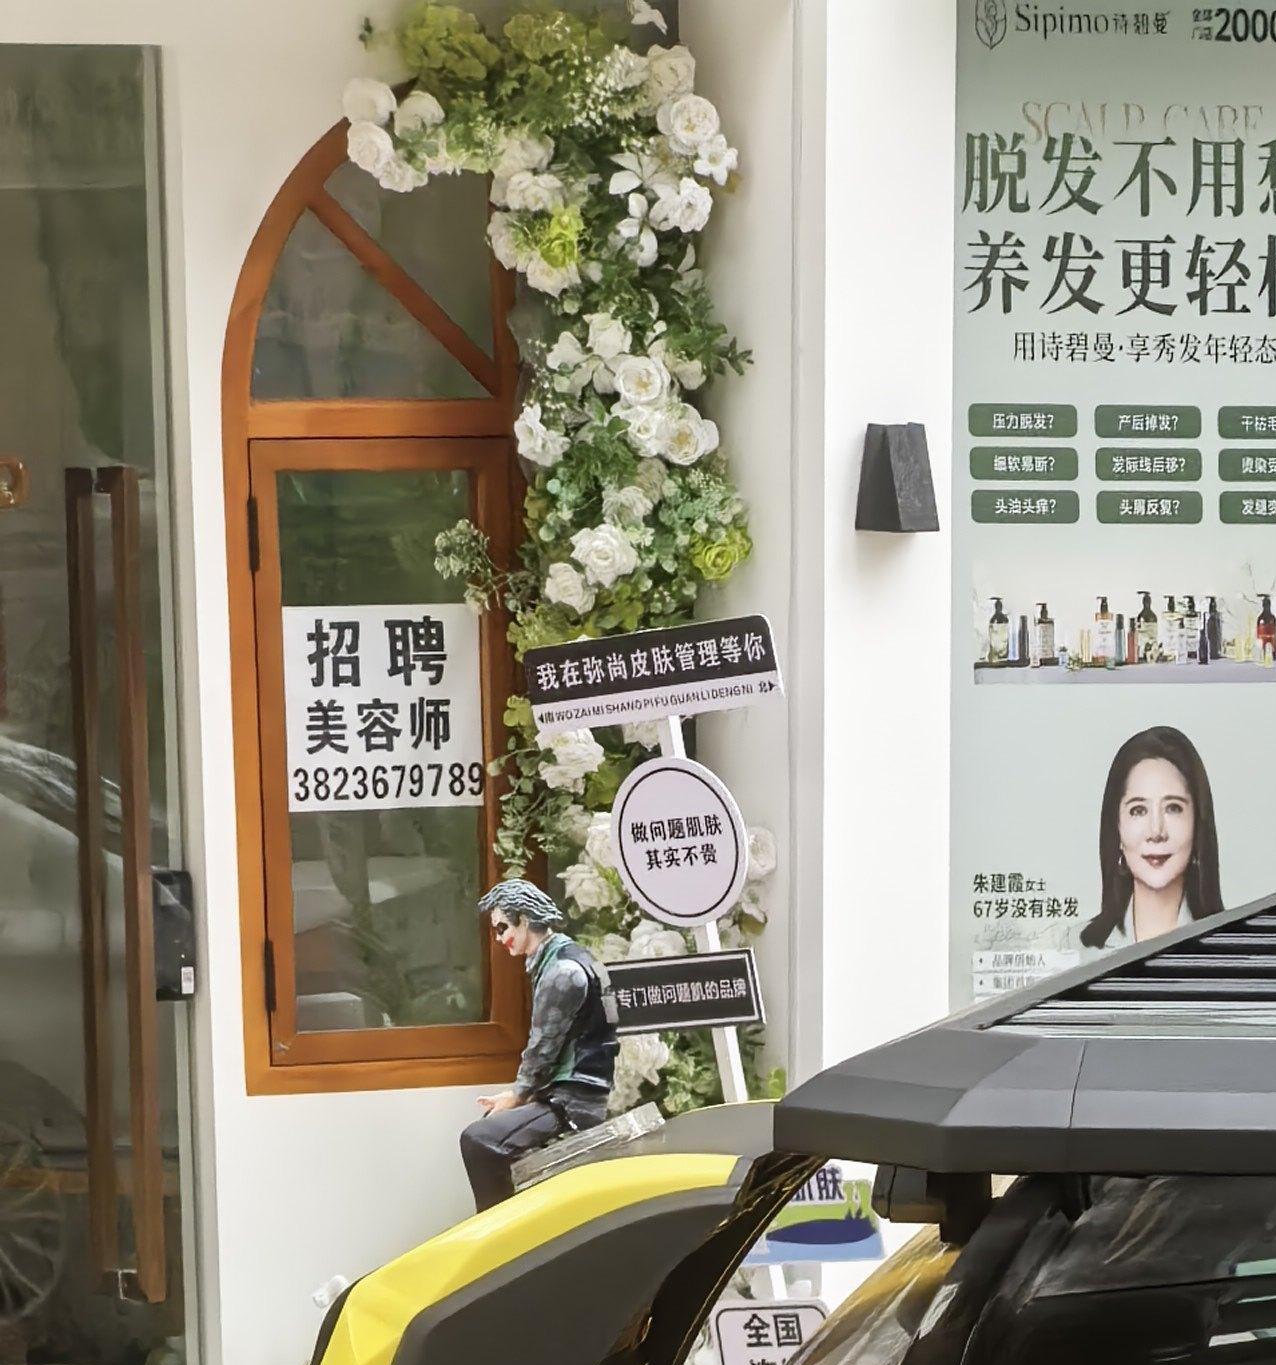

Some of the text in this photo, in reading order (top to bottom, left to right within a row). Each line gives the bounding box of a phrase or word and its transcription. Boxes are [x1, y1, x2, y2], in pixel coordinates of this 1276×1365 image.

[1015, 6, 1108, 40] Sipimo
[307, 615, 448, 689] 招聘
[536, 632, 765, 692] 我在弥尚皮肤管理等你
[305, 696, 452, 756] 美容师
[293, 762, 484, 801] 3823679789
[631, 814, 722, 843] 做问题肌肤
[646, 843, 718, 871] 其实不贵
[973, 897, 1079, 919] 67岁没有染发
[743, 1313, 803, 1348] 全国
